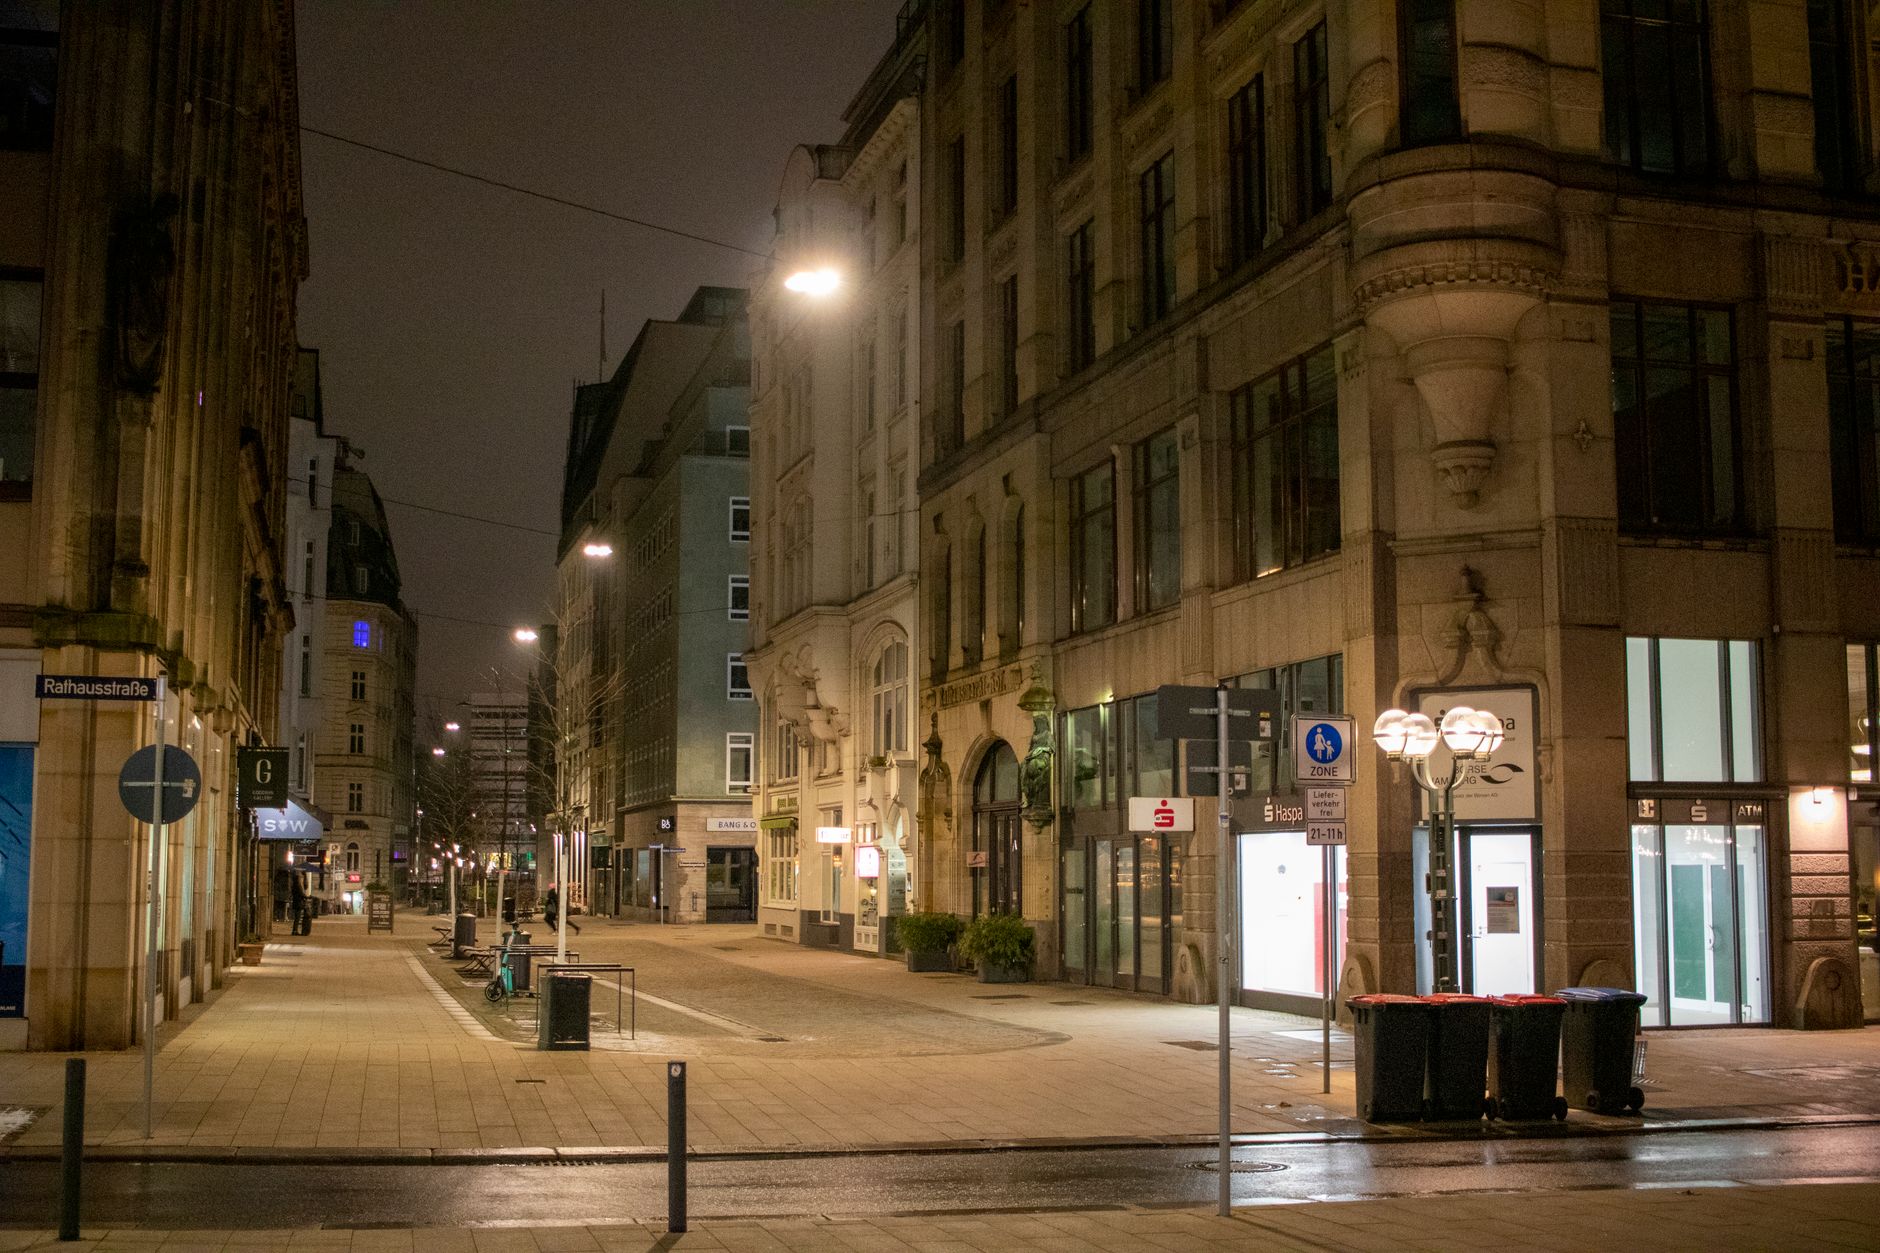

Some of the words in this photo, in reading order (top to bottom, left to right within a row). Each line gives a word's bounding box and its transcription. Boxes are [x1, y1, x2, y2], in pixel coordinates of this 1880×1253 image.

[43, 678, 149, 696] Rathausstraße
[255, 758, 272, 784] G
[1310, 766, 1338, 777] ZONE
[1313, 791, 1339, 799] Liefer-
[1311, 800, 1341, 808] verkehr
[1275, 804, 1303, 825] Haspa
[1320, 809, 1333, 817] frei
[1738, 805, 1762, 816] ATM
[718, 821, 741, 829] BANG
[743, 821, 749, 829] &
